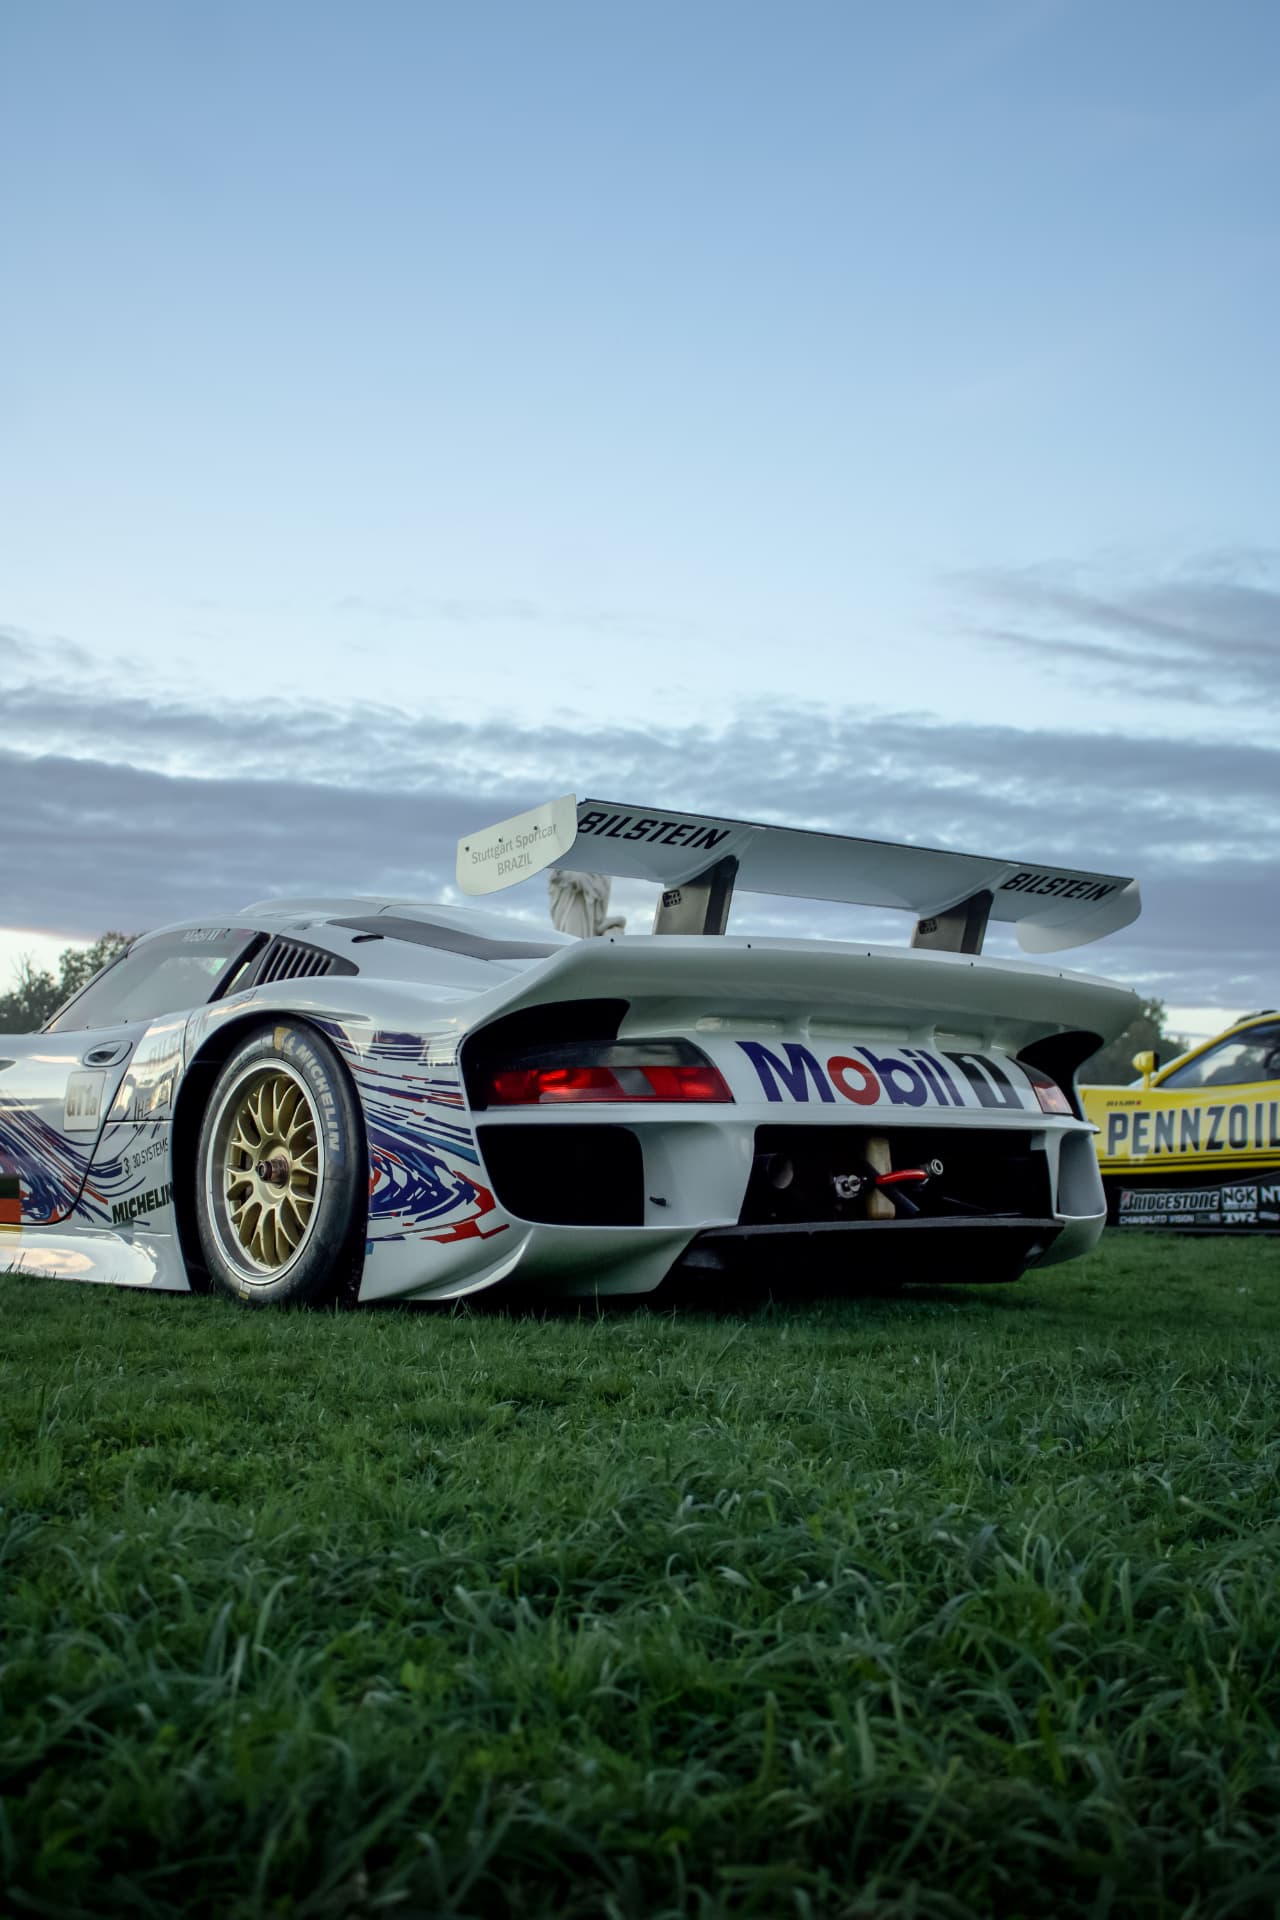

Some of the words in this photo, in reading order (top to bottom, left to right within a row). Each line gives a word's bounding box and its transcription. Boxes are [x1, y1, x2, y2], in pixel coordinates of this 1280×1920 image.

[471, 840, 513, 865] Stuttgart
[515, 823, 557, 850] Sportcar
[578, 812, 731, 850] BILSTEIN
[497, 852, 533, 876] BRAZIL
[999, 872, 1116, 901] BILSTEIN
[735, 1041, 965, 1107] Mobil
[296, 1044, 341, 1152] MICHELIN
[1106, 1102, 1280, 1156] PENNZOIL
[142, 1137, 169, 1164] SYSTEMS
[1120, 1191, 1220, 1212] BRIDGESTONE
[1224, 1188, 1256, 1203] NGK
